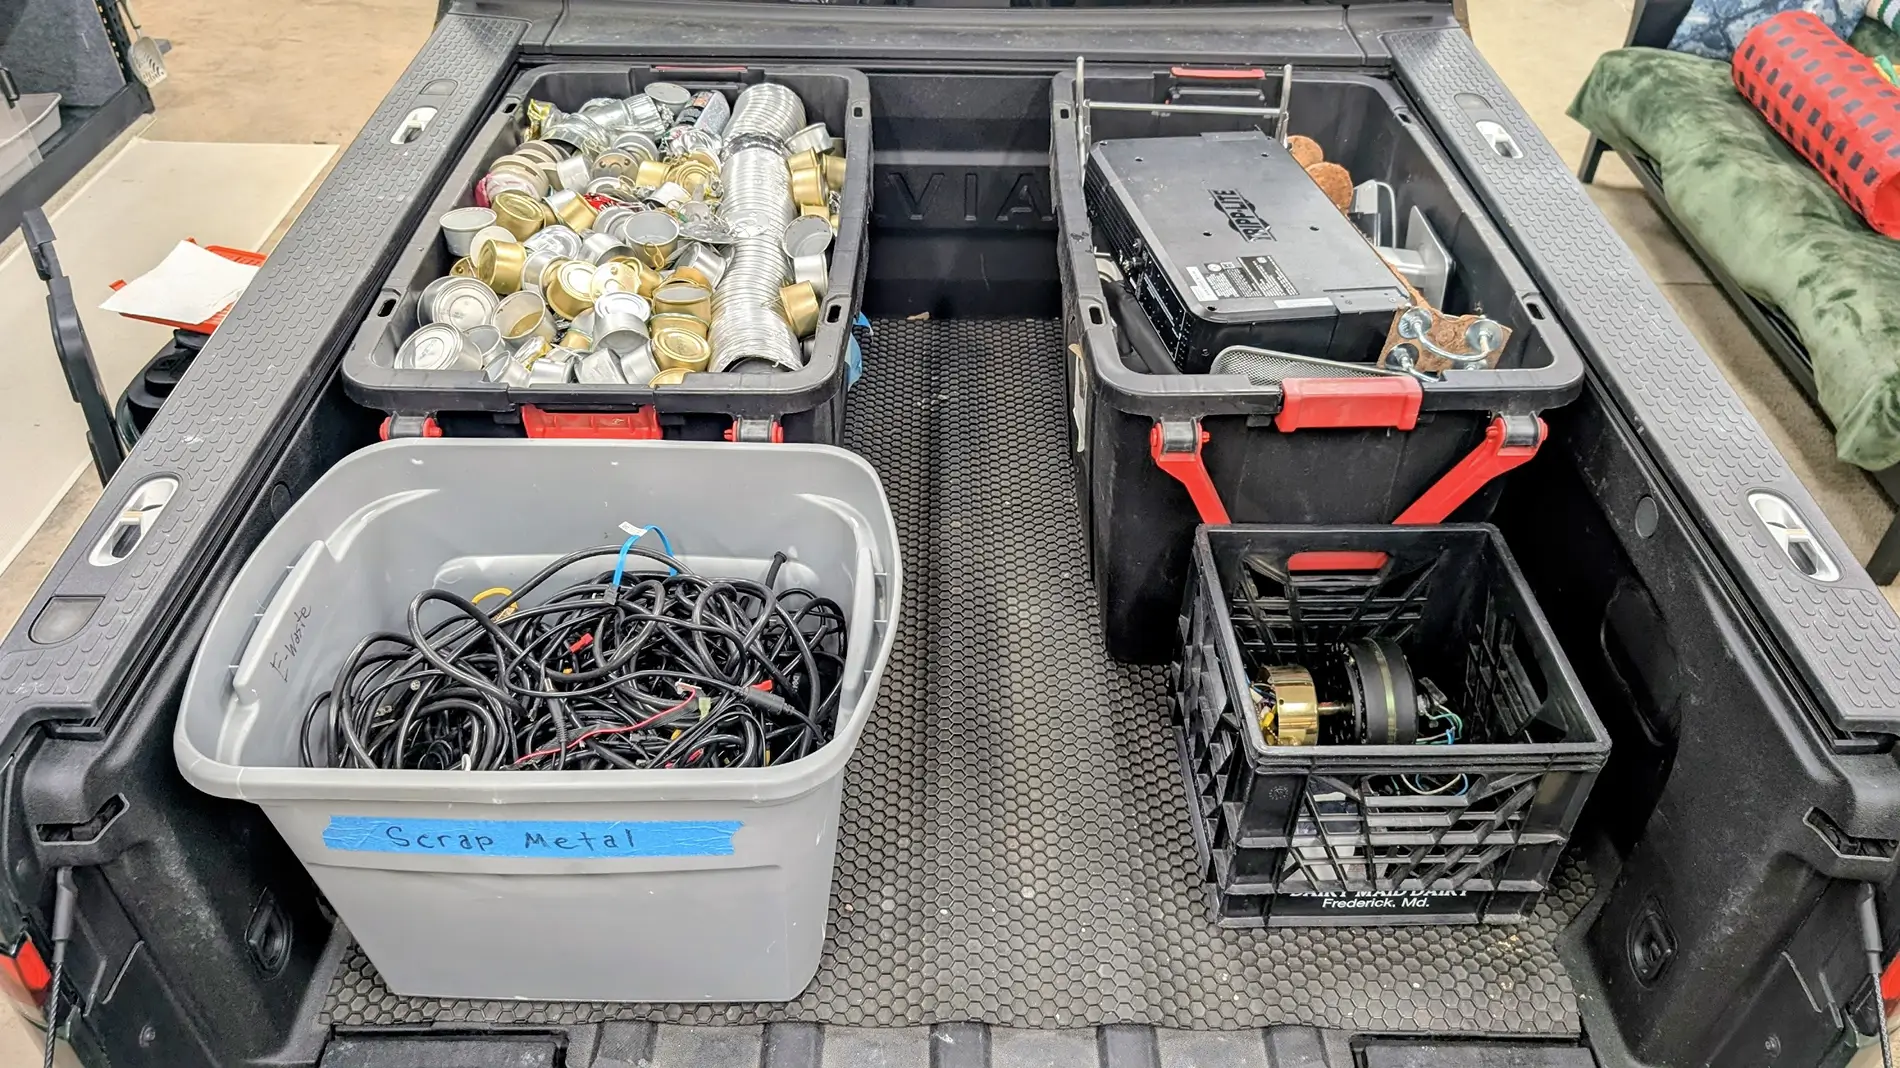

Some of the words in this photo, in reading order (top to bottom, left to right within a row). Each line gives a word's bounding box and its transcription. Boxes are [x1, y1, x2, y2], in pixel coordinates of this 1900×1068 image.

[875, 172, 1054, 221] VIA
[385, 825, 494, 851] Scrap
[524, 828, 635, 850] Metal
[1401, 897, 1430, 908] Md.
